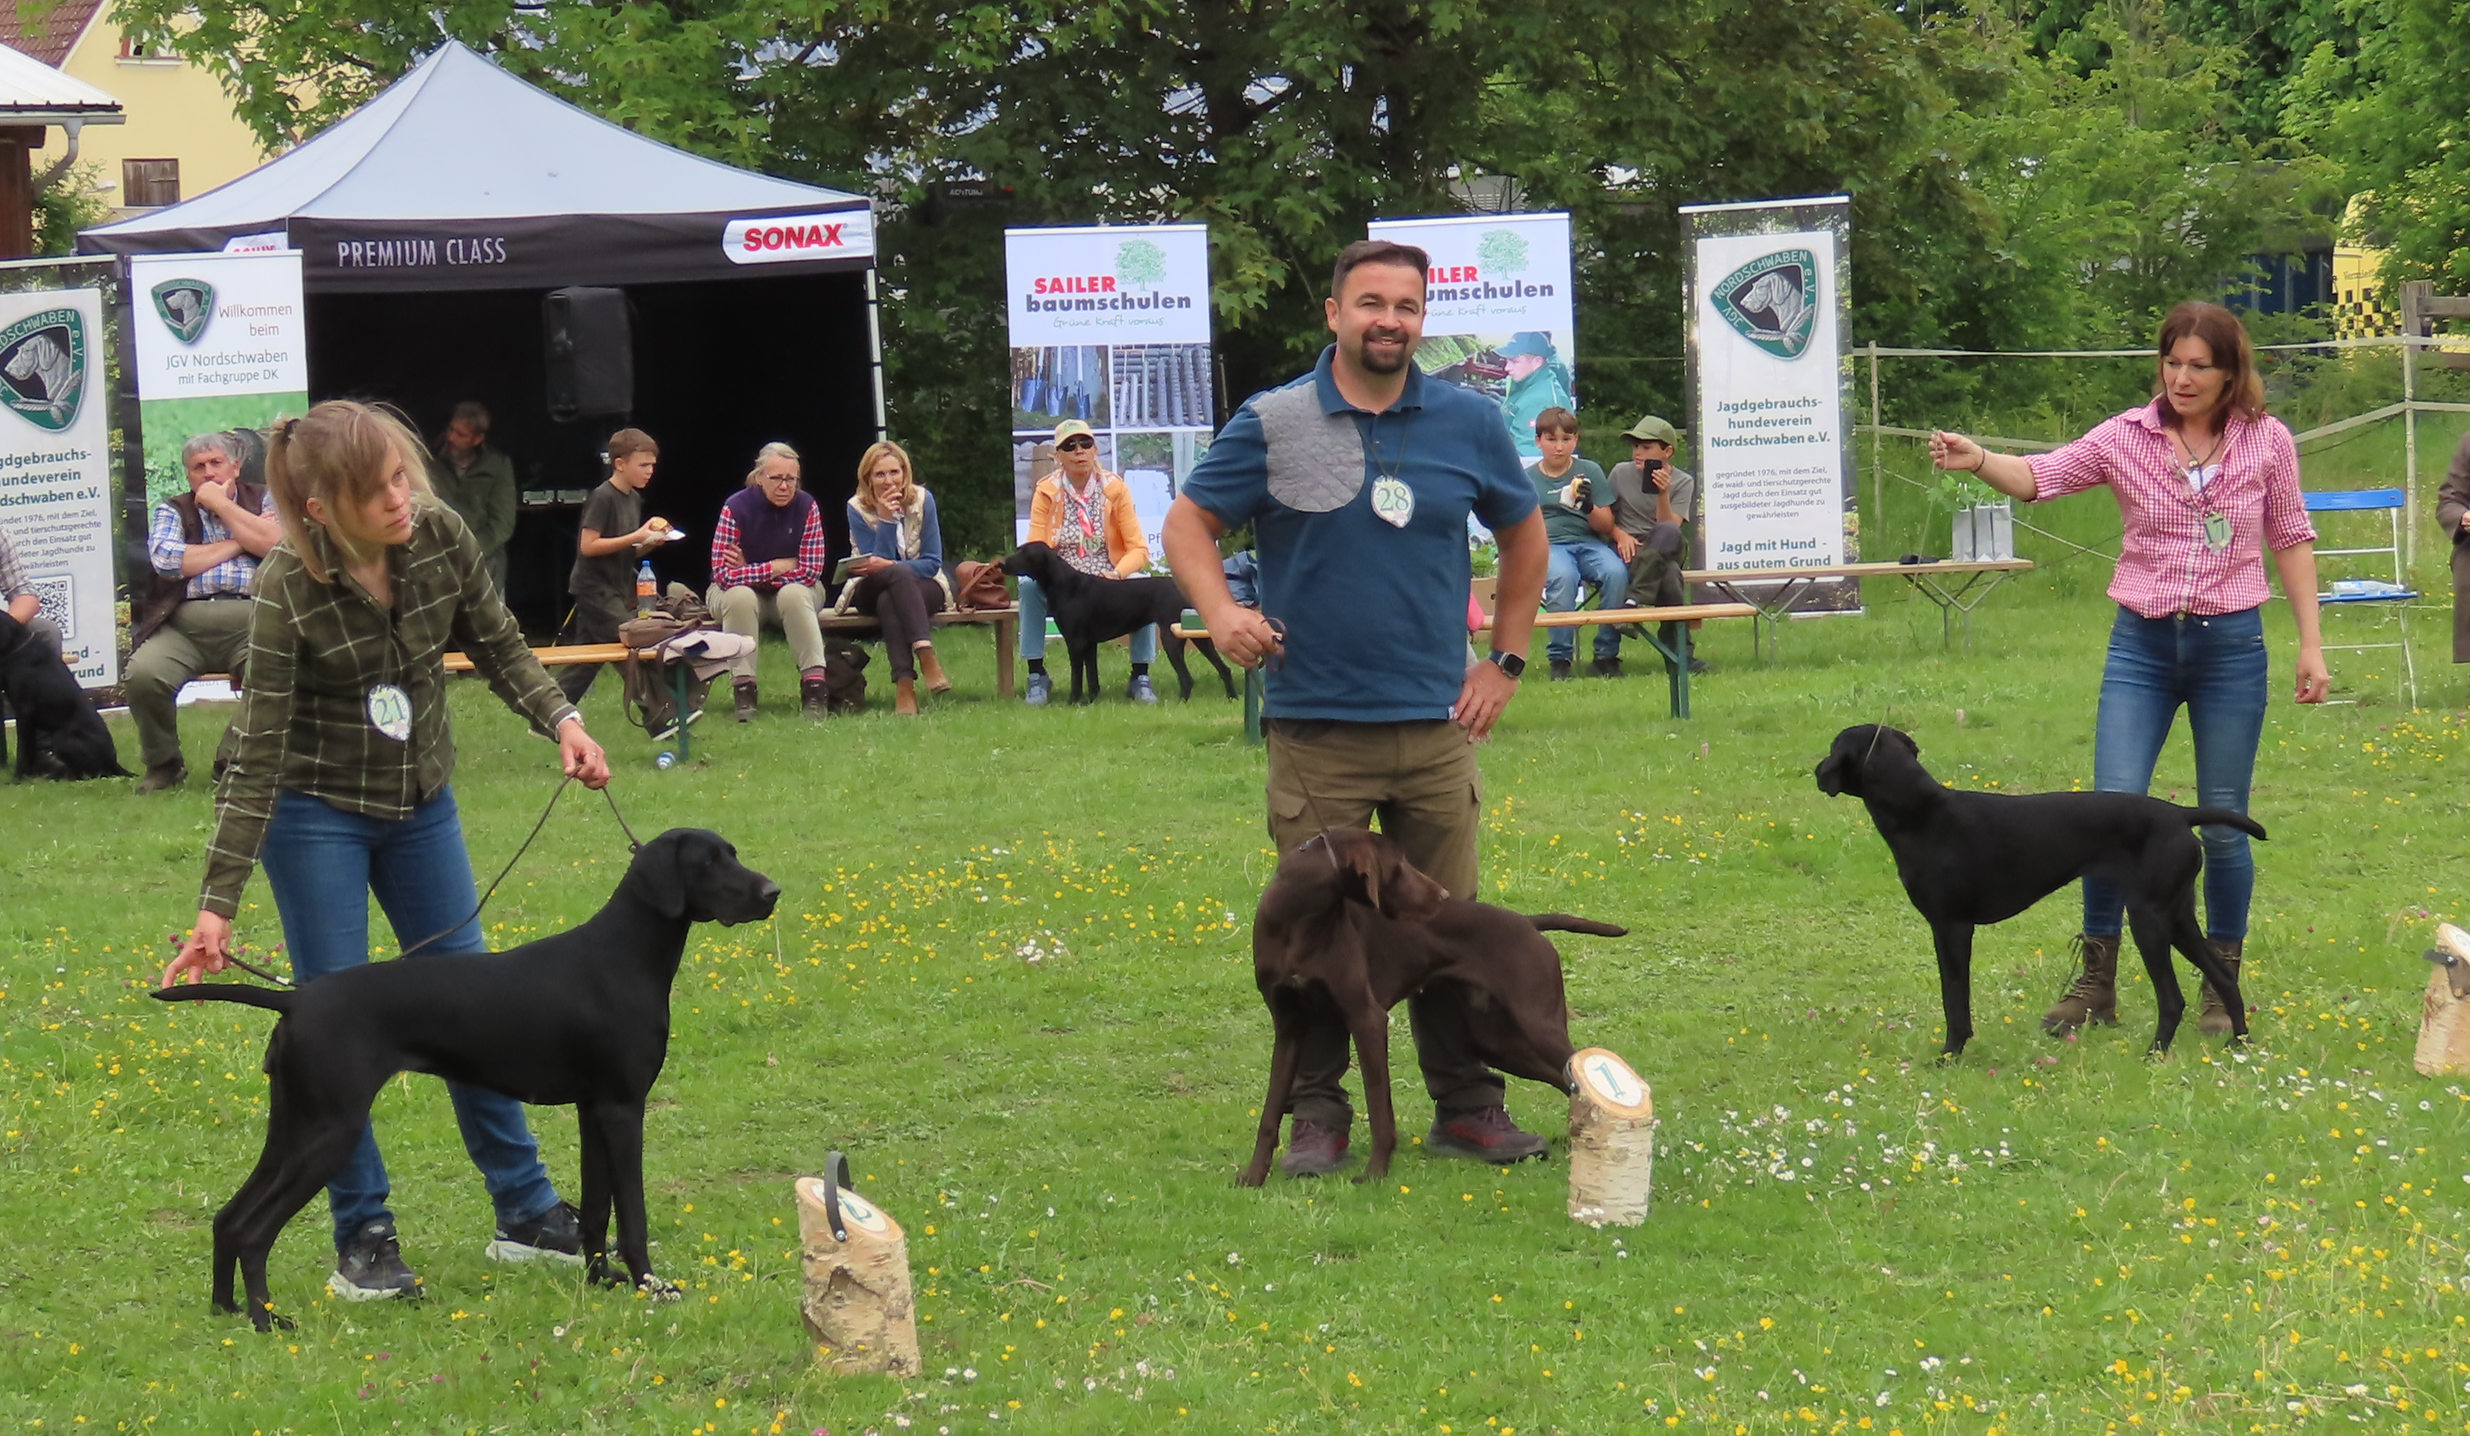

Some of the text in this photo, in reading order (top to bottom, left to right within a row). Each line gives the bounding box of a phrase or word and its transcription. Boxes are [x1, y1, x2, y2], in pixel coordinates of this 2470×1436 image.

[742, 222, 844, 252] SONAX
[337, 237, 507, 267] PREMIUM CLASS
[1428, 266, 1479, 284] ILER
[1713, 250, 1808, 299] NORDSCHWABEN
[1034, 276, 1116, 295] SAILER
[1427, 279, 1554, 302] umschulen
[1026, 290, 1191, 313] baumschulen
[1490, 305, 1527, 315] voraus
[218, 304, 292, 319] Willkommen
[0, 310, 75, 350] DSCHWABEN
[249, 323, 279, 337] beim
[1053, 316, 1091, 328] Grüne
[1129, 316, 1165, 326] voraus
[166, 350, 288, 370] JGV Nordschwaben
[178, 369, 279, 385] mit Fachgruppe DK
[1716, 396, 1823, 414] Jagdgebrauchs-
[1728, 414, 1812, 429] hundeverein
[1711, 431, 1830, 448] Nordschwaben e.V.
[0, 448, 92, 469] dgebrauchs-
[0, 468, 81, 487] undeverein
[1793, 467, 1810, 475] dem
[1712, 481, 1724, 489] die
[0, 486, 101, 506] dschwaben e.V.
[1376, 486, 1409, 511] 28
[1722, 491, 1740, 500] Jagd
[1741, 490, 1763, 498] durch
[1773, 499, 1814, 508] Jagdhunde
[1720, 540, 1751, 555] Jagd
[1754, 539, 1777, 551] mit
[1780, 537, 1816, 550] Hund
[1716, 560, 1740, 571] aus
[1789, 555, 1831, 567] Grund
[72, 664, 105, 679] rund
[375, 693, 405, 726] 21
[1592, 1062, 1626, 1098] 1
